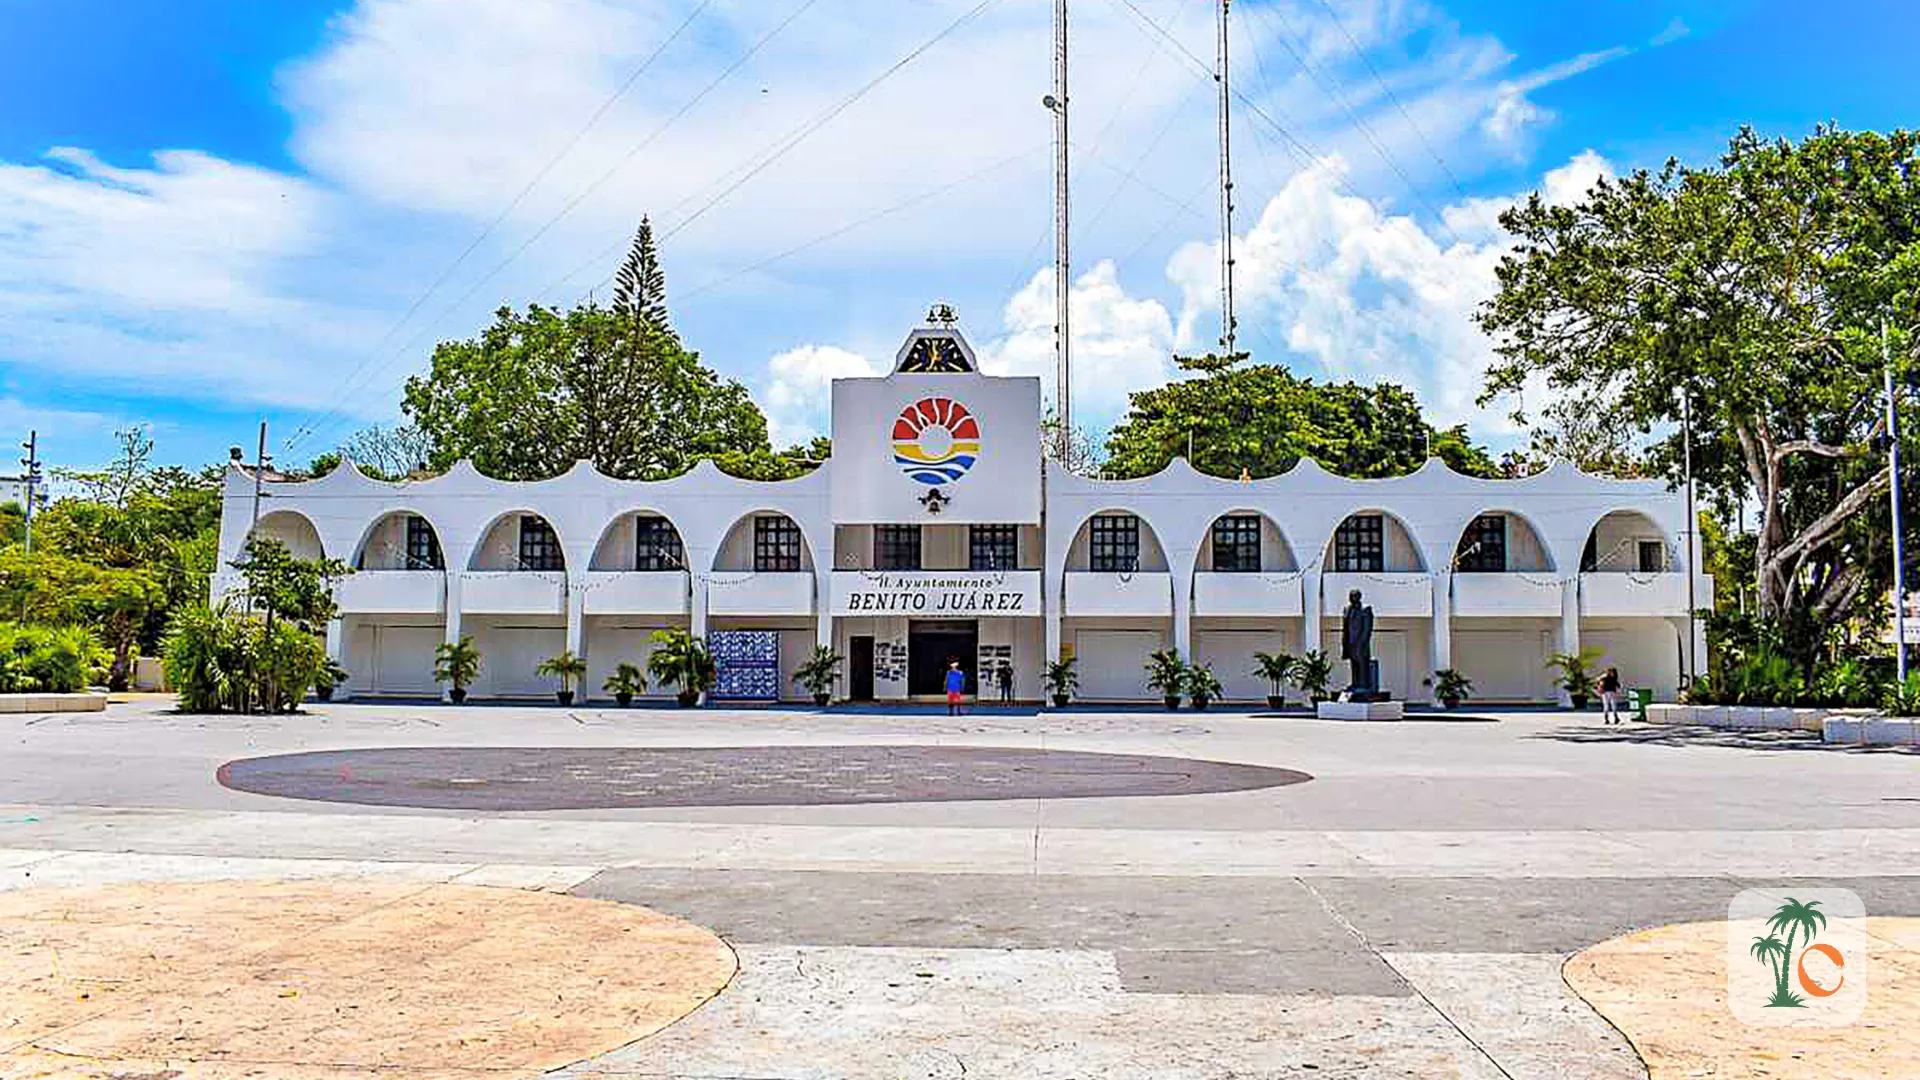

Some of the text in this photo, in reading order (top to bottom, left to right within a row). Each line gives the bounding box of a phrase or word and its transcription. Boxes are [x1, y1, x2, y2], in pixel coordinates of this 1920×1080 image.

[896, 577, 993, 590] Ayuntamiento
[849, 591, 1024, 610] BENITO JUÁREZ
